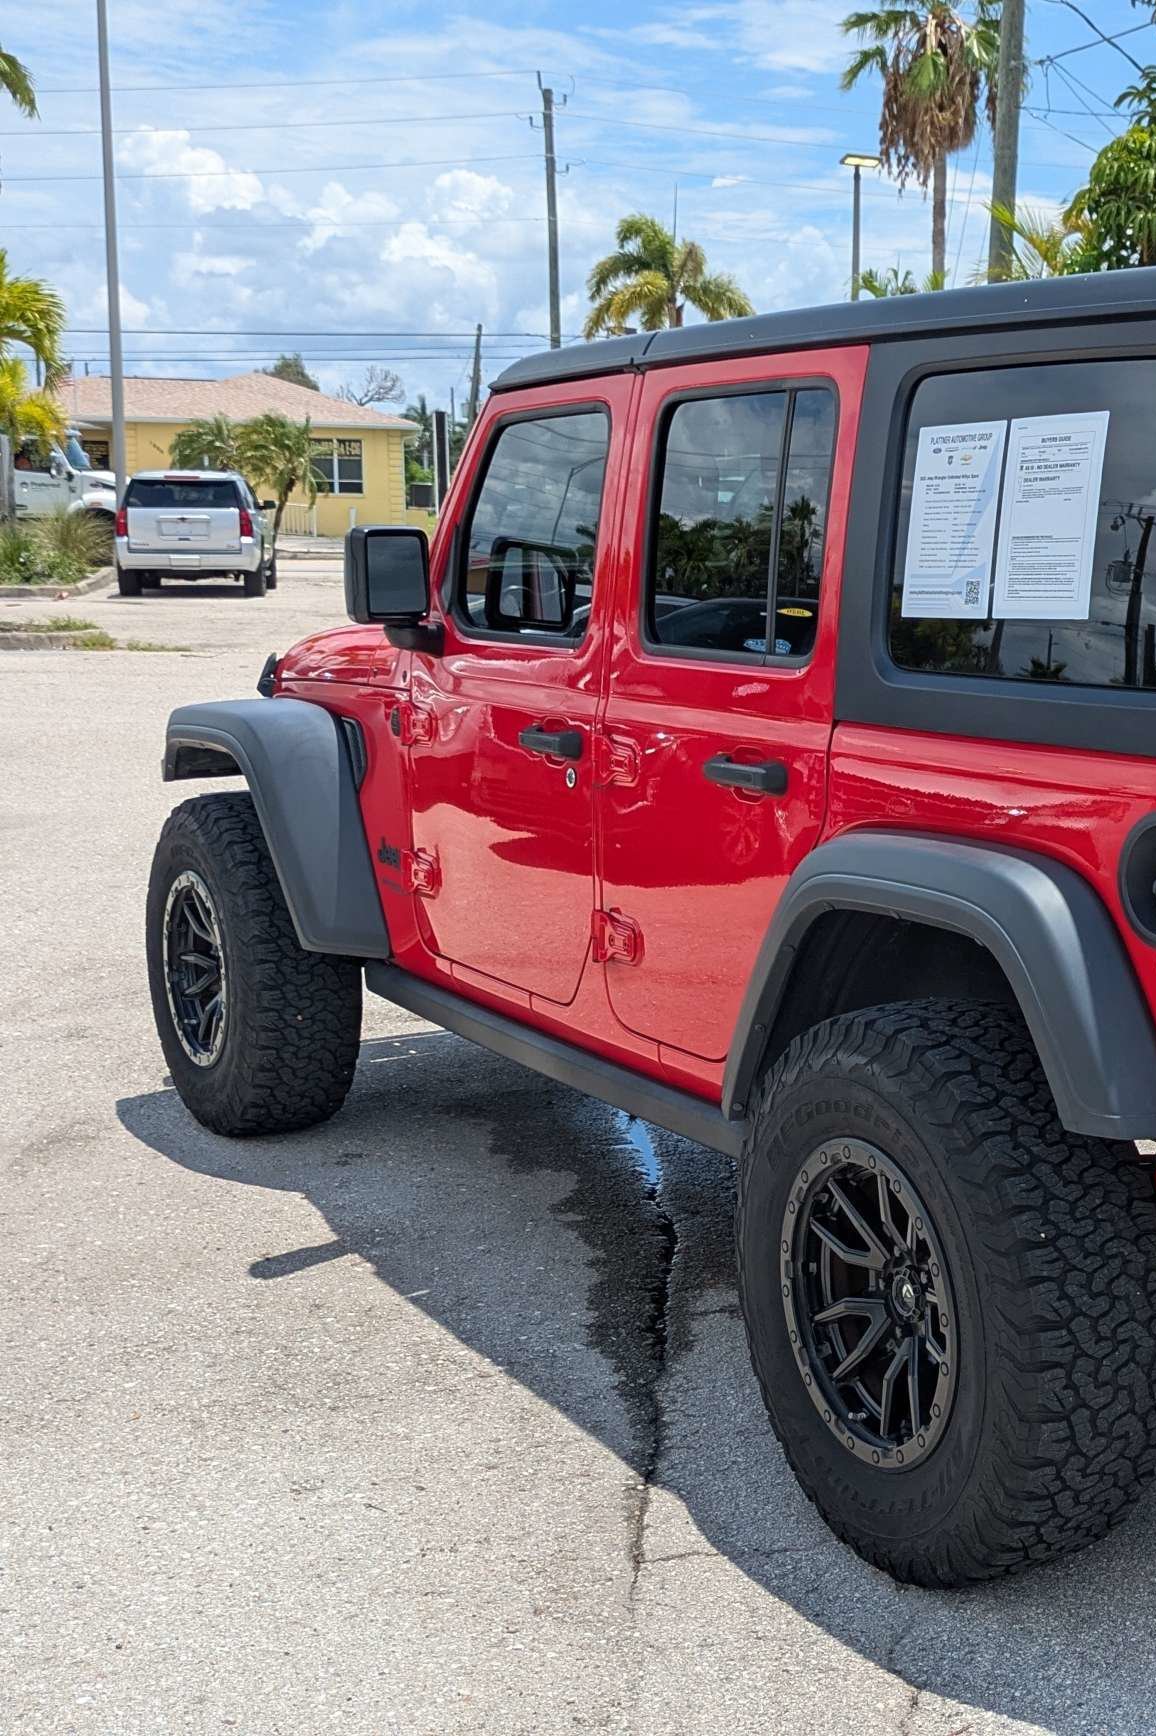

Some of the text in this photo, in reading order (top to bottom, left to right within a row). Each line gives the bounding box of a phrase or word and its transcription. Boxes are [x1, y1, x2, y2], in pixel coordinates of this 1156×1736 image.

[951, 434, 977, 443] AUTOMOTIVE
[977, 432, 993, 442] GROUP
[1041, 436, 1058, 444] BUYERS
